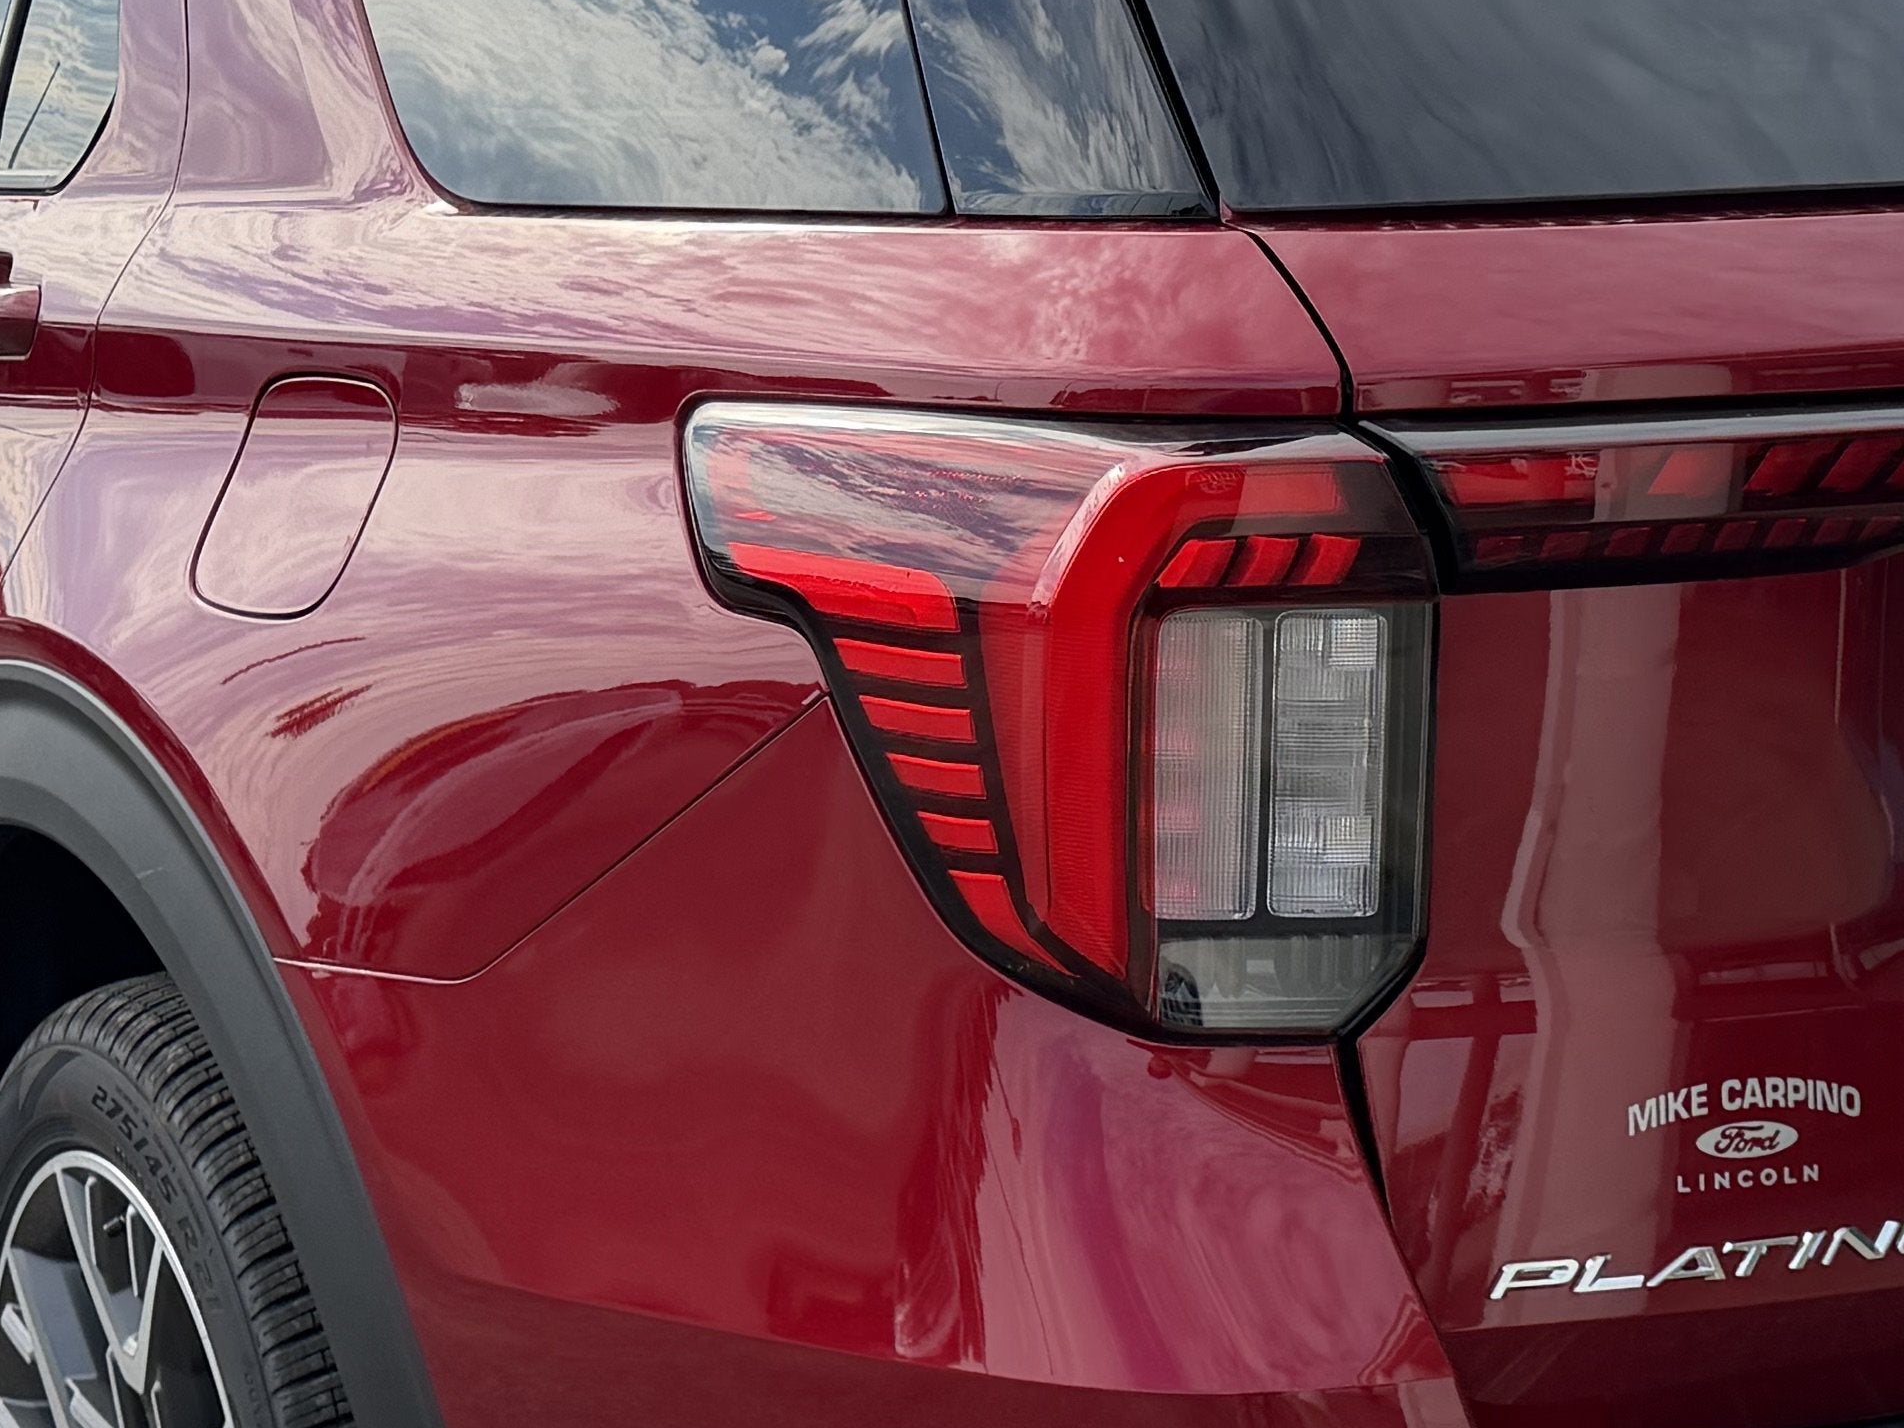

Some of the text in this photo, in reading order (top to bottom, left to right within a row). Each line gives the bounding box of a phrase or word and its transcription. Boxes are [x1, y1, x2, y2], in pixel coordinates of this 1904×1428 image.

[1628, 1077, 1862, 1136] MIKE CARPINO
[1714, 1124, 1780, 1154] Ford
[1676, 1164, 1820, 1194] LINCOLN
